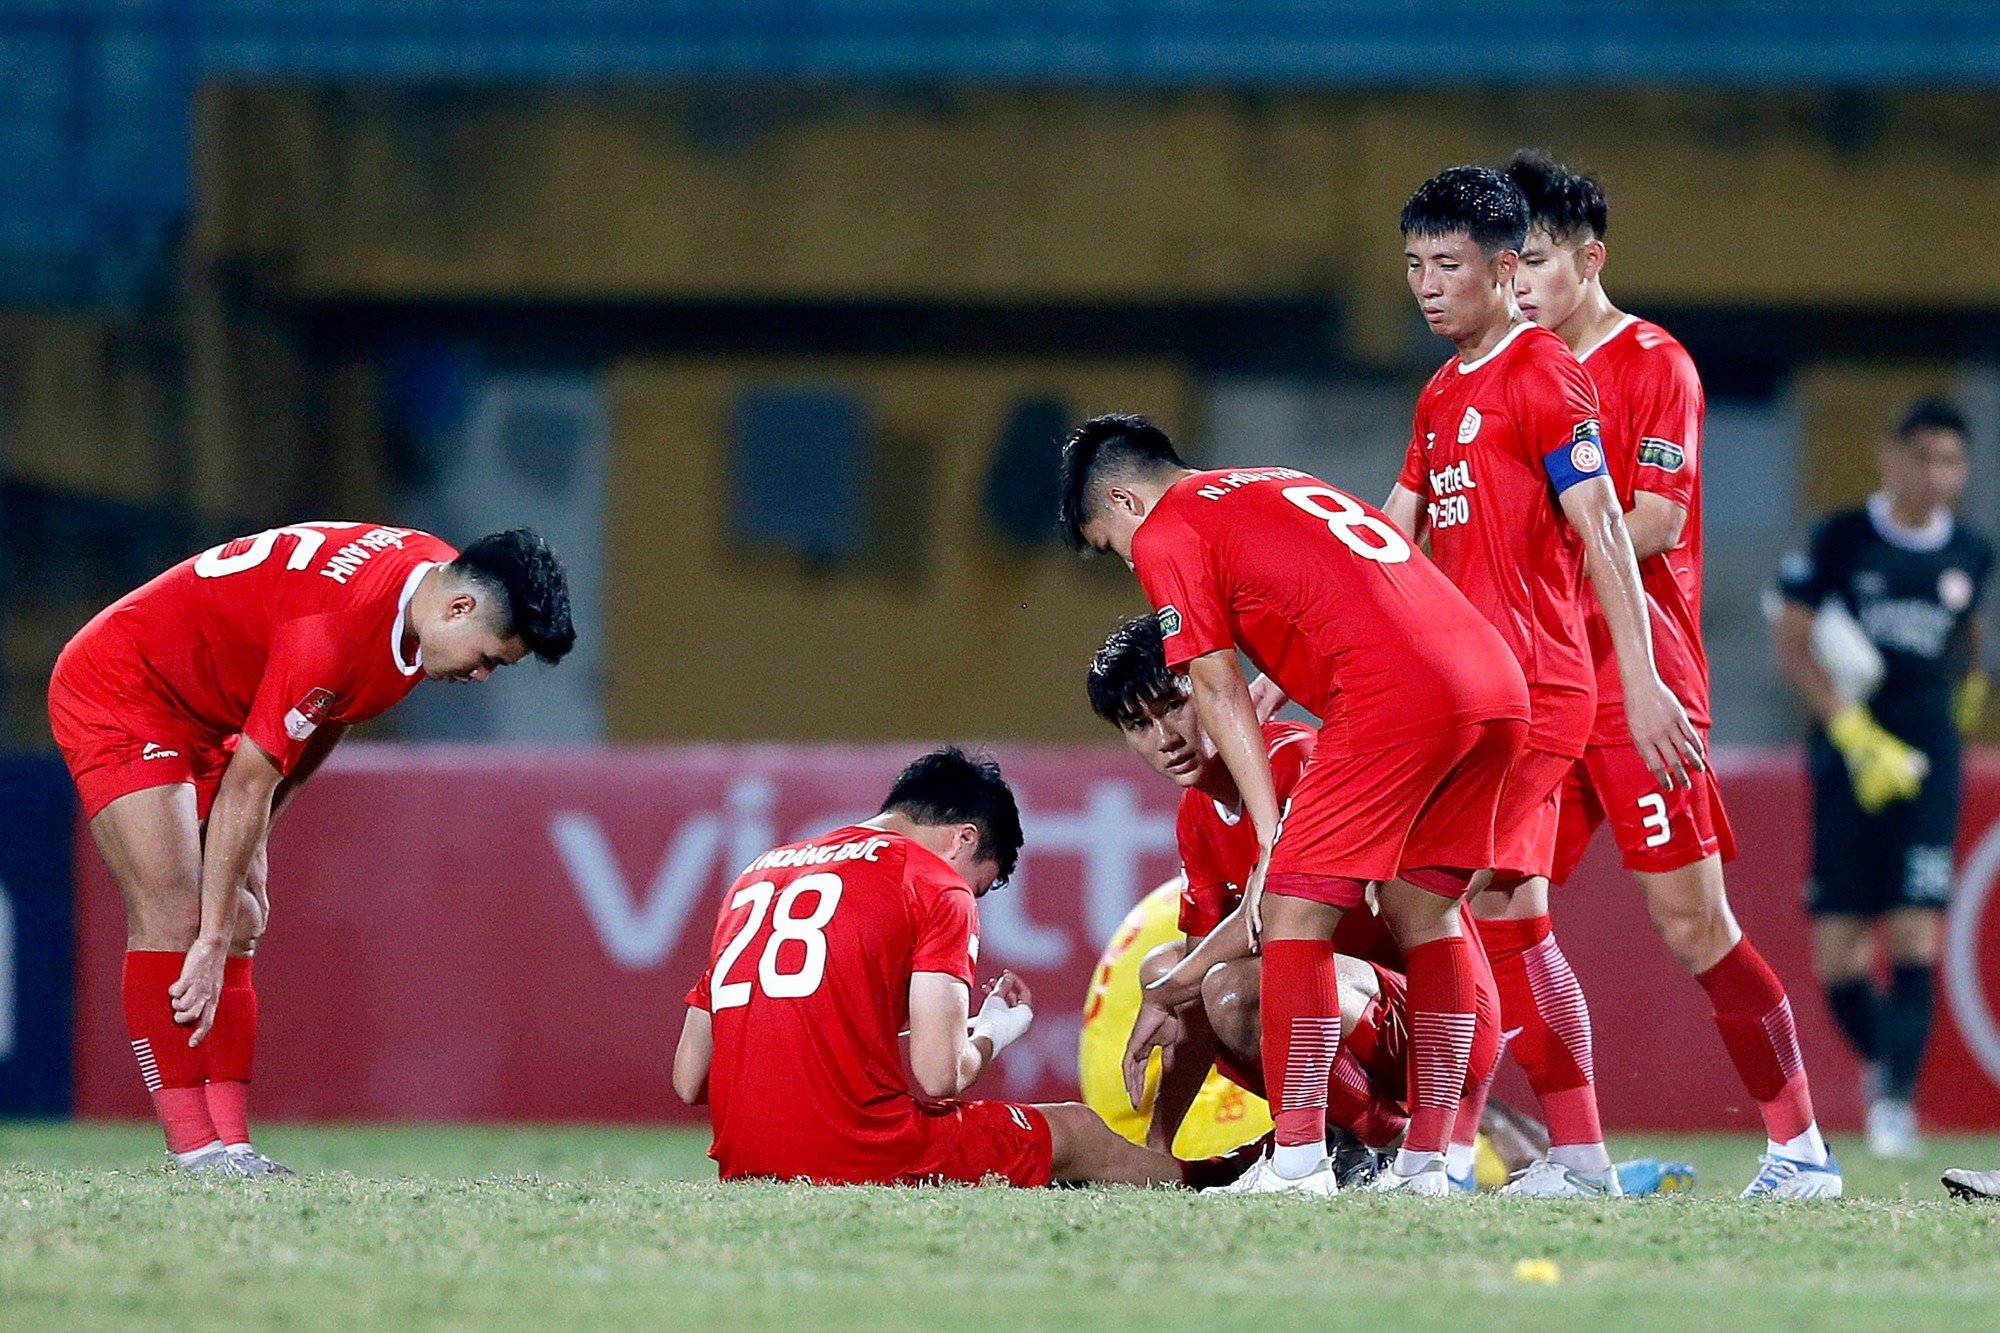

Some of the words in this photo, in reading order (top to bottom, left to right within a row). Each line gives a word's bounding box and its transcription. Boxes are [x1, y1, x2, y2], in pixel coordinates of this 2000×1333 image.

[194, 521, 363, 579] 6
[1281, 486, 1411, 564] 8
[319, 542, 372, 584] ANH
[1637, 792, 1671, 848] 3
[710, 872, 843, 1014] 28
